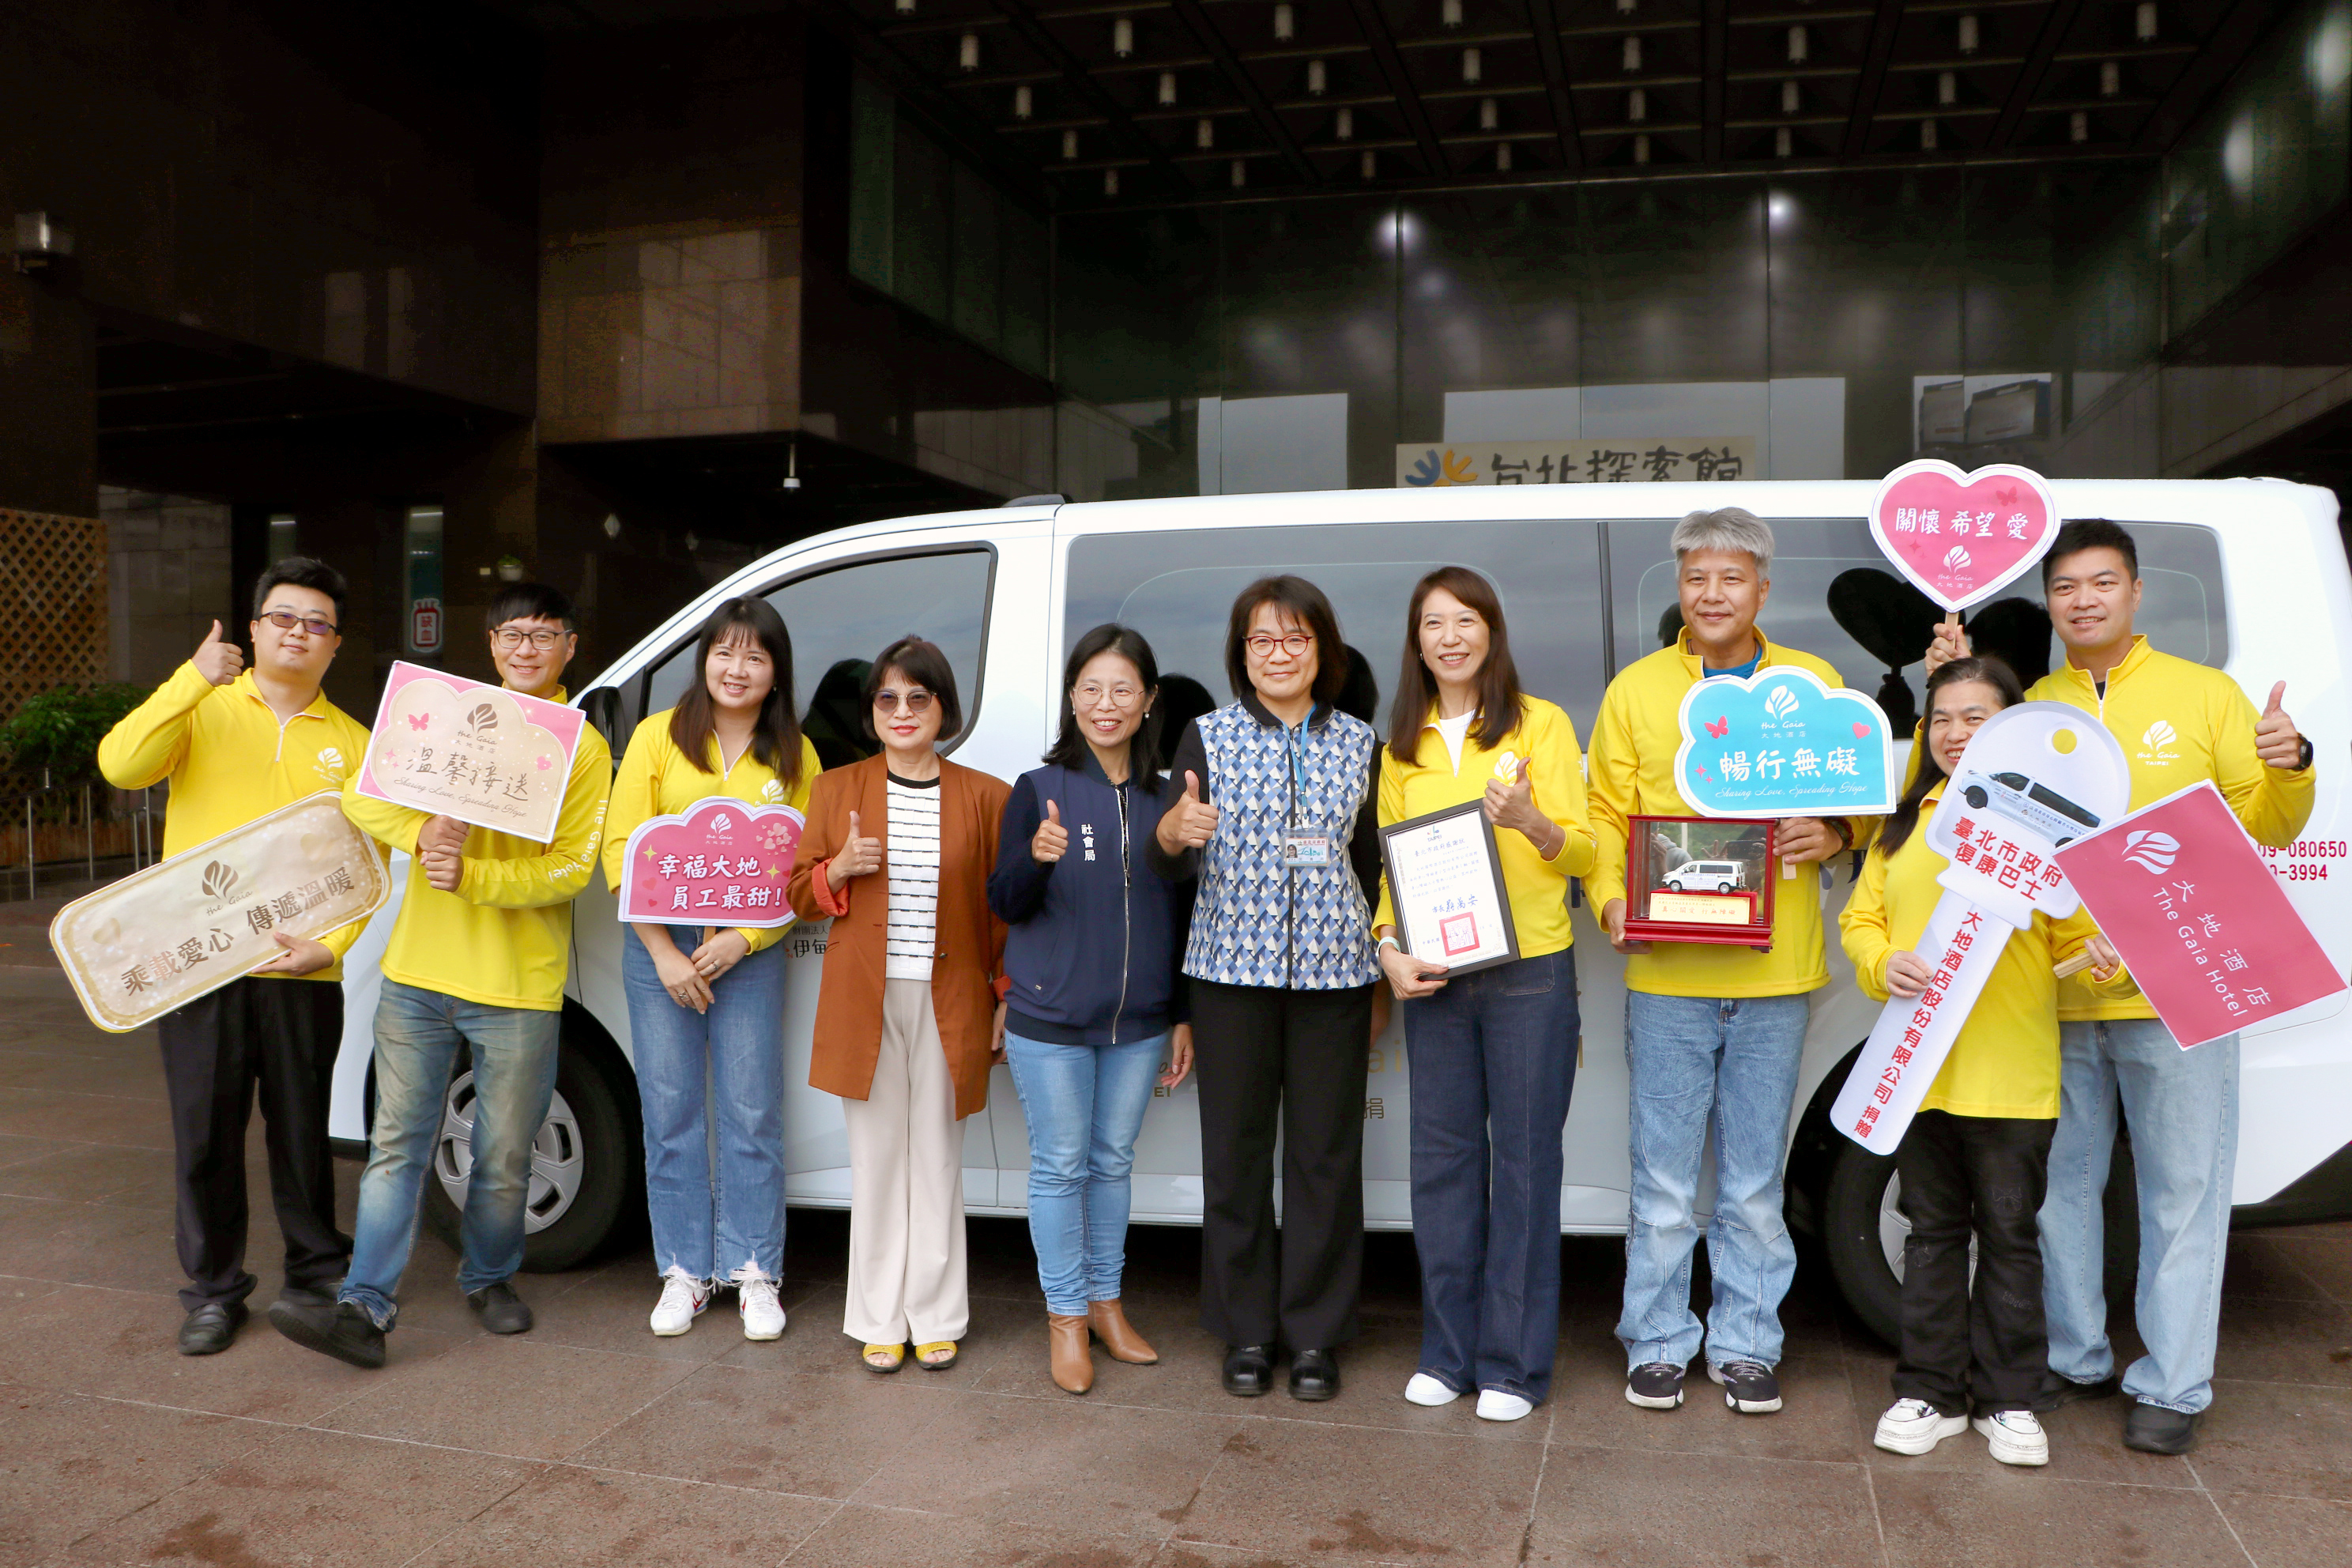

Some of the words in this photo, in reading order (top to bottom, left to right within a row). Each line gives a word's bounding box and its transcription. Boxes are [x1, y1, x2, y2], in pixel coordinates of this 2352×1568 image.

[1491, 445, 1743, 484] 台北探索館
[1895, 507, 1941, 534] 關懷
[1949, 511, 1996, 537] 希望
[2007, 513, 2028, 541] 愛
[457, 730, 472, 739] the
[476, 735, 498, 745] Gaia
[1761, 721, 1777, 730] the
[1782, 720, 1806, 729] Gaia
[1719, 746, 1860, 782] 暢行無礙
[394, 777, 427, 793] Sharing
[458, 793, 500, 812] Spreading
[1715, 786, 1752, 801] Sharing
[1788, 783, 1837, 798] Spreading
[1839, 781, 1868, 796] Hope
[581, 831, 601, 862] Gaia
[1081, 824, 1096, 861] 社會局
[1952, 816, 2064, 888] 臺北市政府
[658, 854, 761, 880] 幸福大地
[1954, 842, 2042, 901] 復康巴士
[206, 904, 224, 917] the
[228, 890, 253, 905] Gaia
[121, 927, 235, 997] 乘載愛心
[246, 866, 355, 935] 傳遞溫暖
[2172, 880, 2271, 1006] 大地酒店
[2153, 887, 2179, 922] The
[2178, 925, 2207, 966] Gaia
[2206, 969, 2248, 1017] Hotel
[1873, 910, 1983, 1105] 大地酒店股份有限公司
[1854, 1105, 1880, 1139] 捐贈
